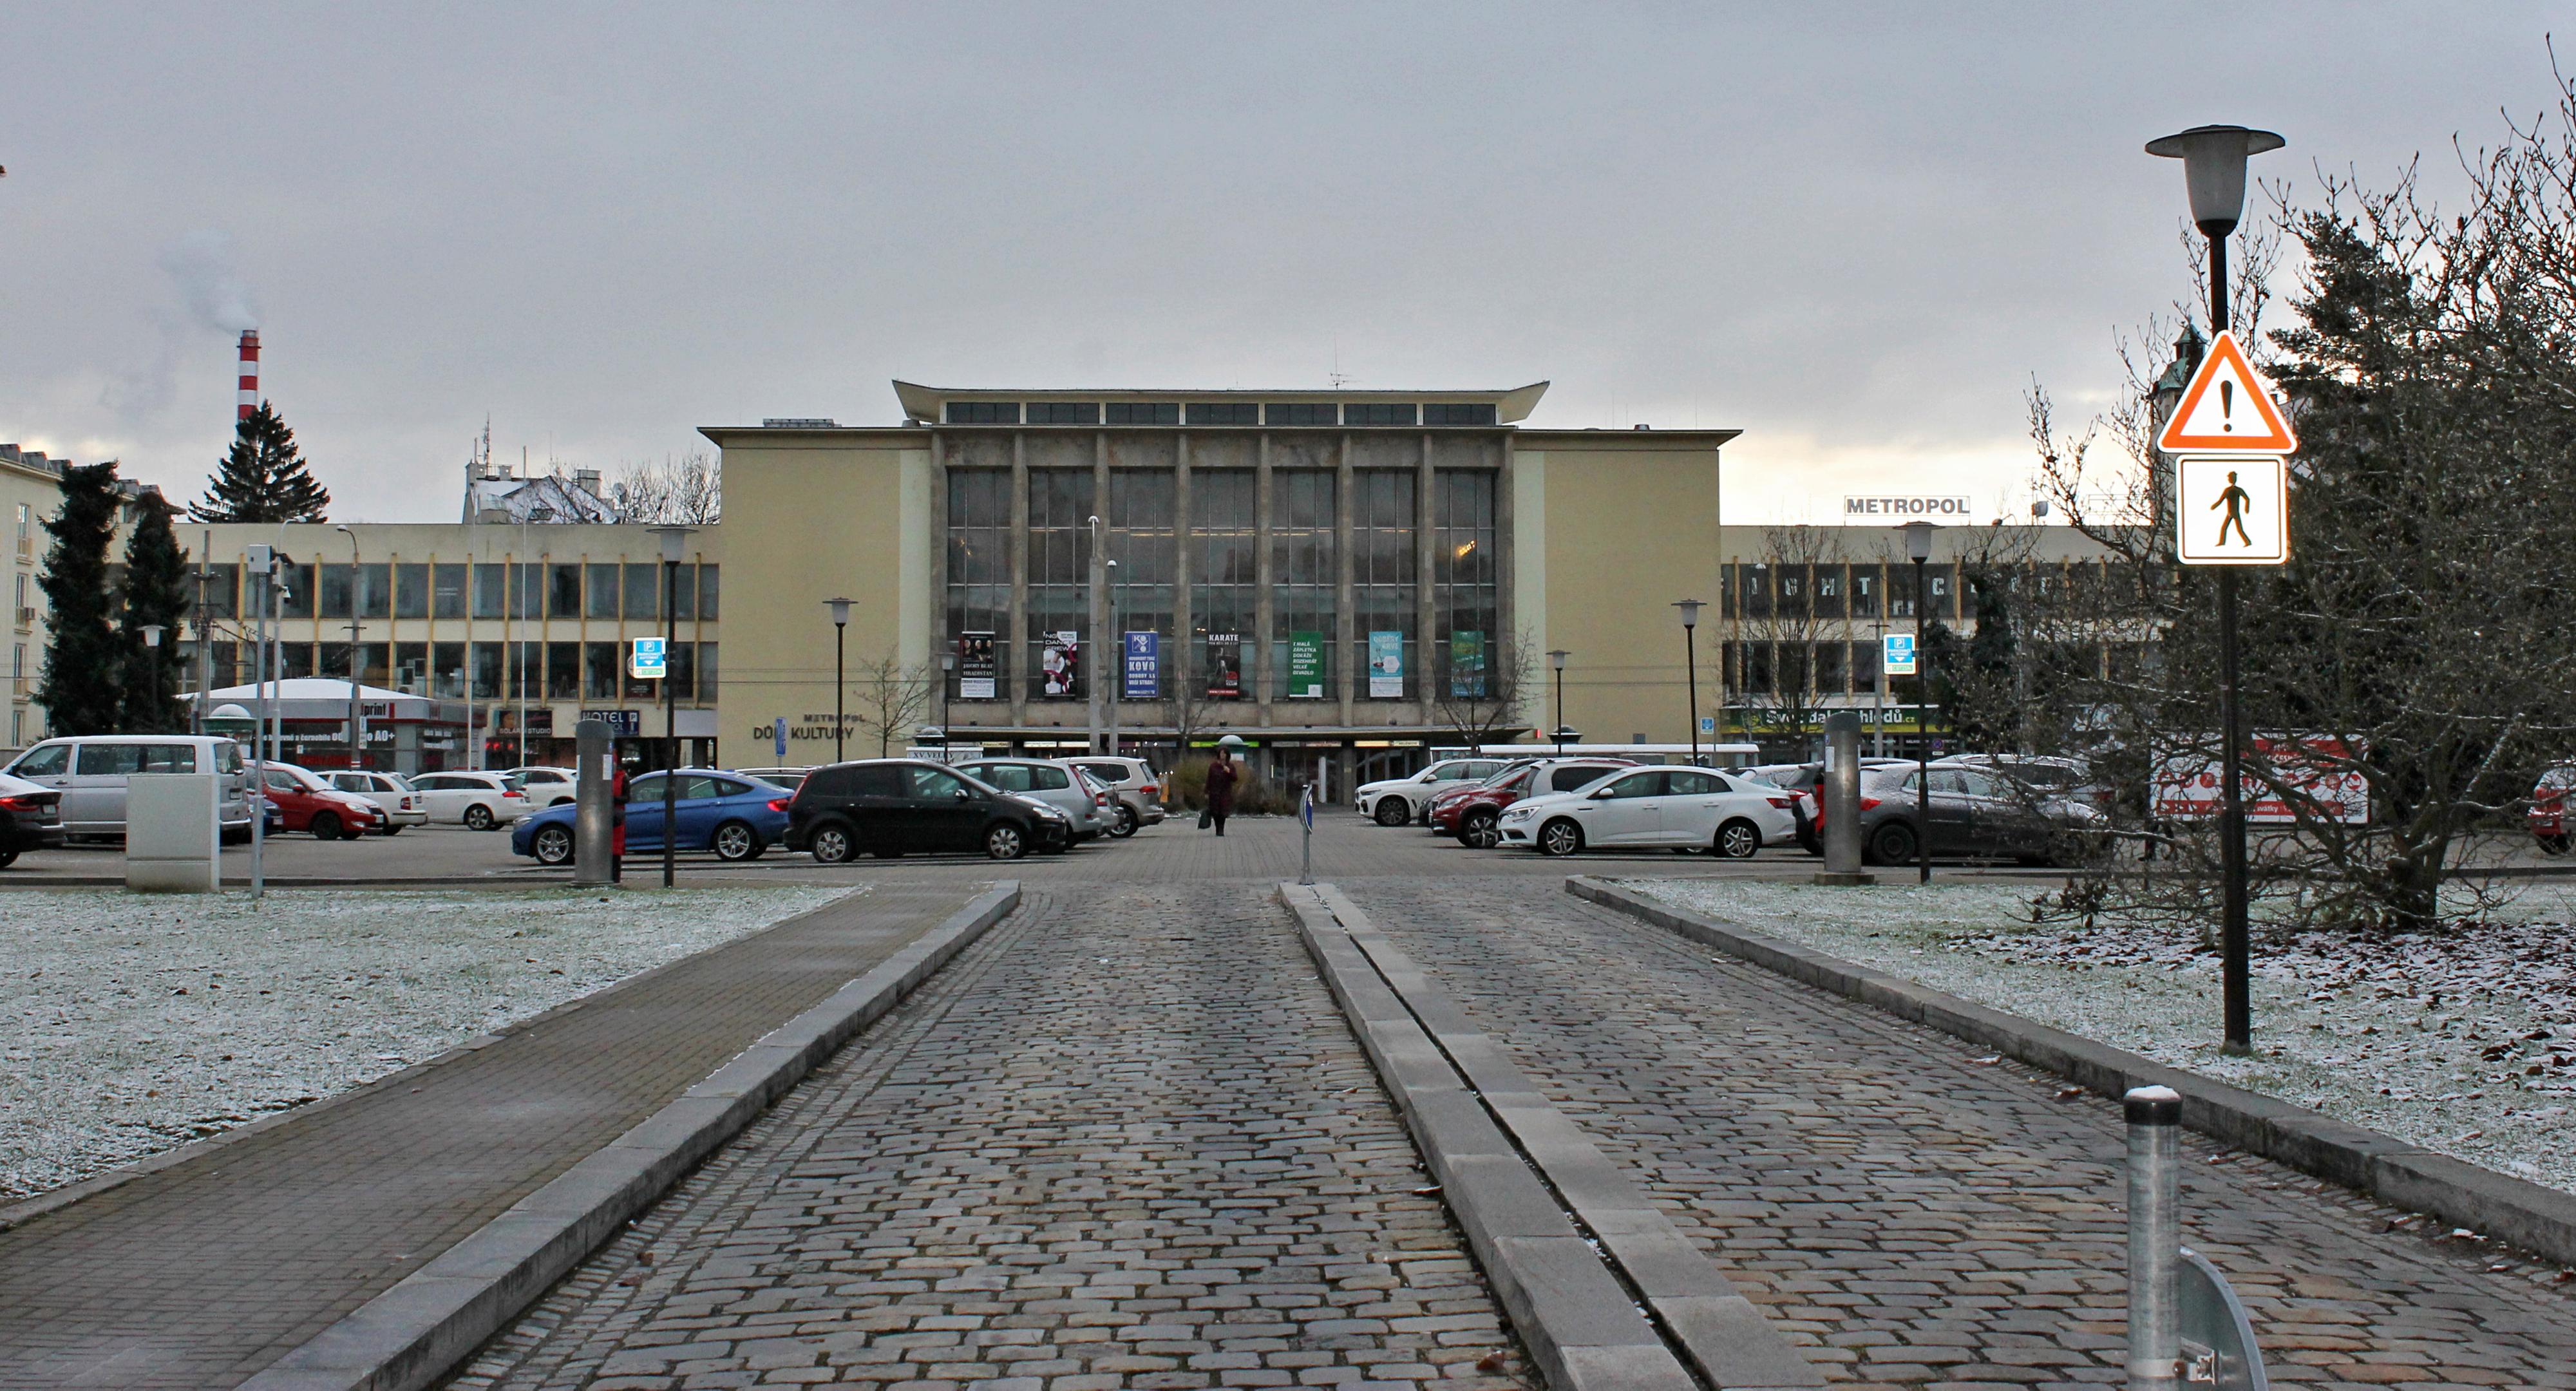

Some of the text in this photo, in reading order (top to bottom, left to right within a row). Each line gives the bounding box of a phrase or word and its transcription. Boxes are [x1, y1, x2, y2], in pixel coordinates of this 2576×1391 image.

[1846, 498, 1970, 514] METROPOL
[1129, 661, 1155, 671] KOVO
[582, 712, 623, 723] HOTEL
